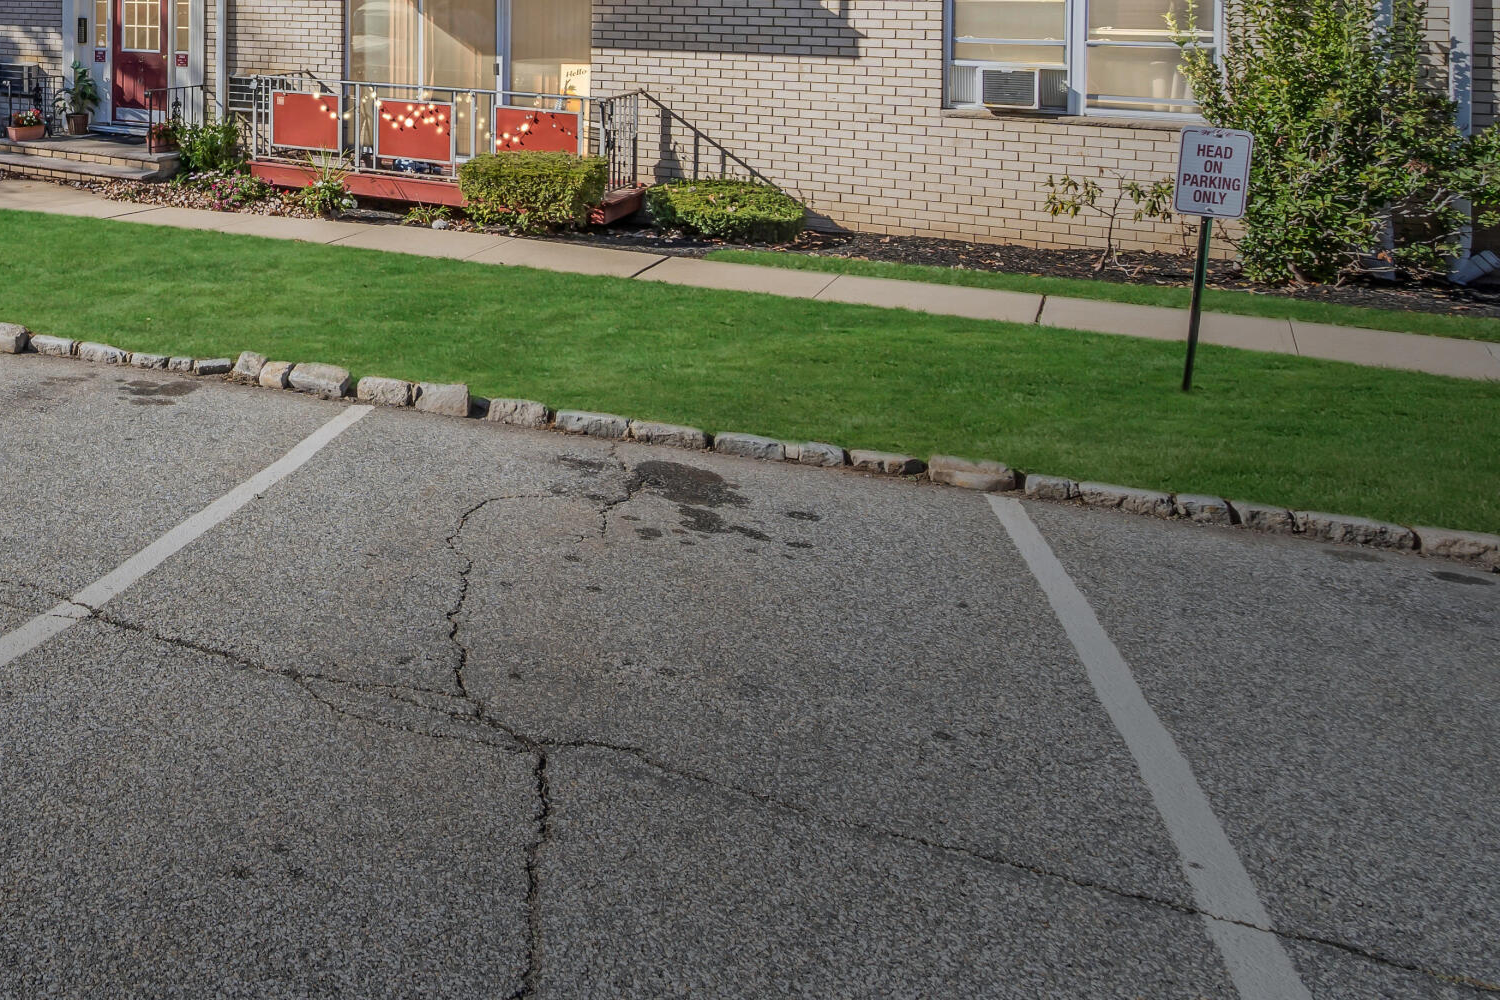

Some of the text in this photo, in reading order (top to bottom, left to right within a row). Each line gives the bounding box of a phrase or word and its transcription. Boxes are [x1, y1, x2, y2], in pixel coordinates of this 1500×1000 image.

[1197, 144, 1233, 159] HEAD
[1204, 160, 1223, 174] ON
[1182, 173, 1240, 191] PARKING
[1193, 190, 1227, 205] ONLY
